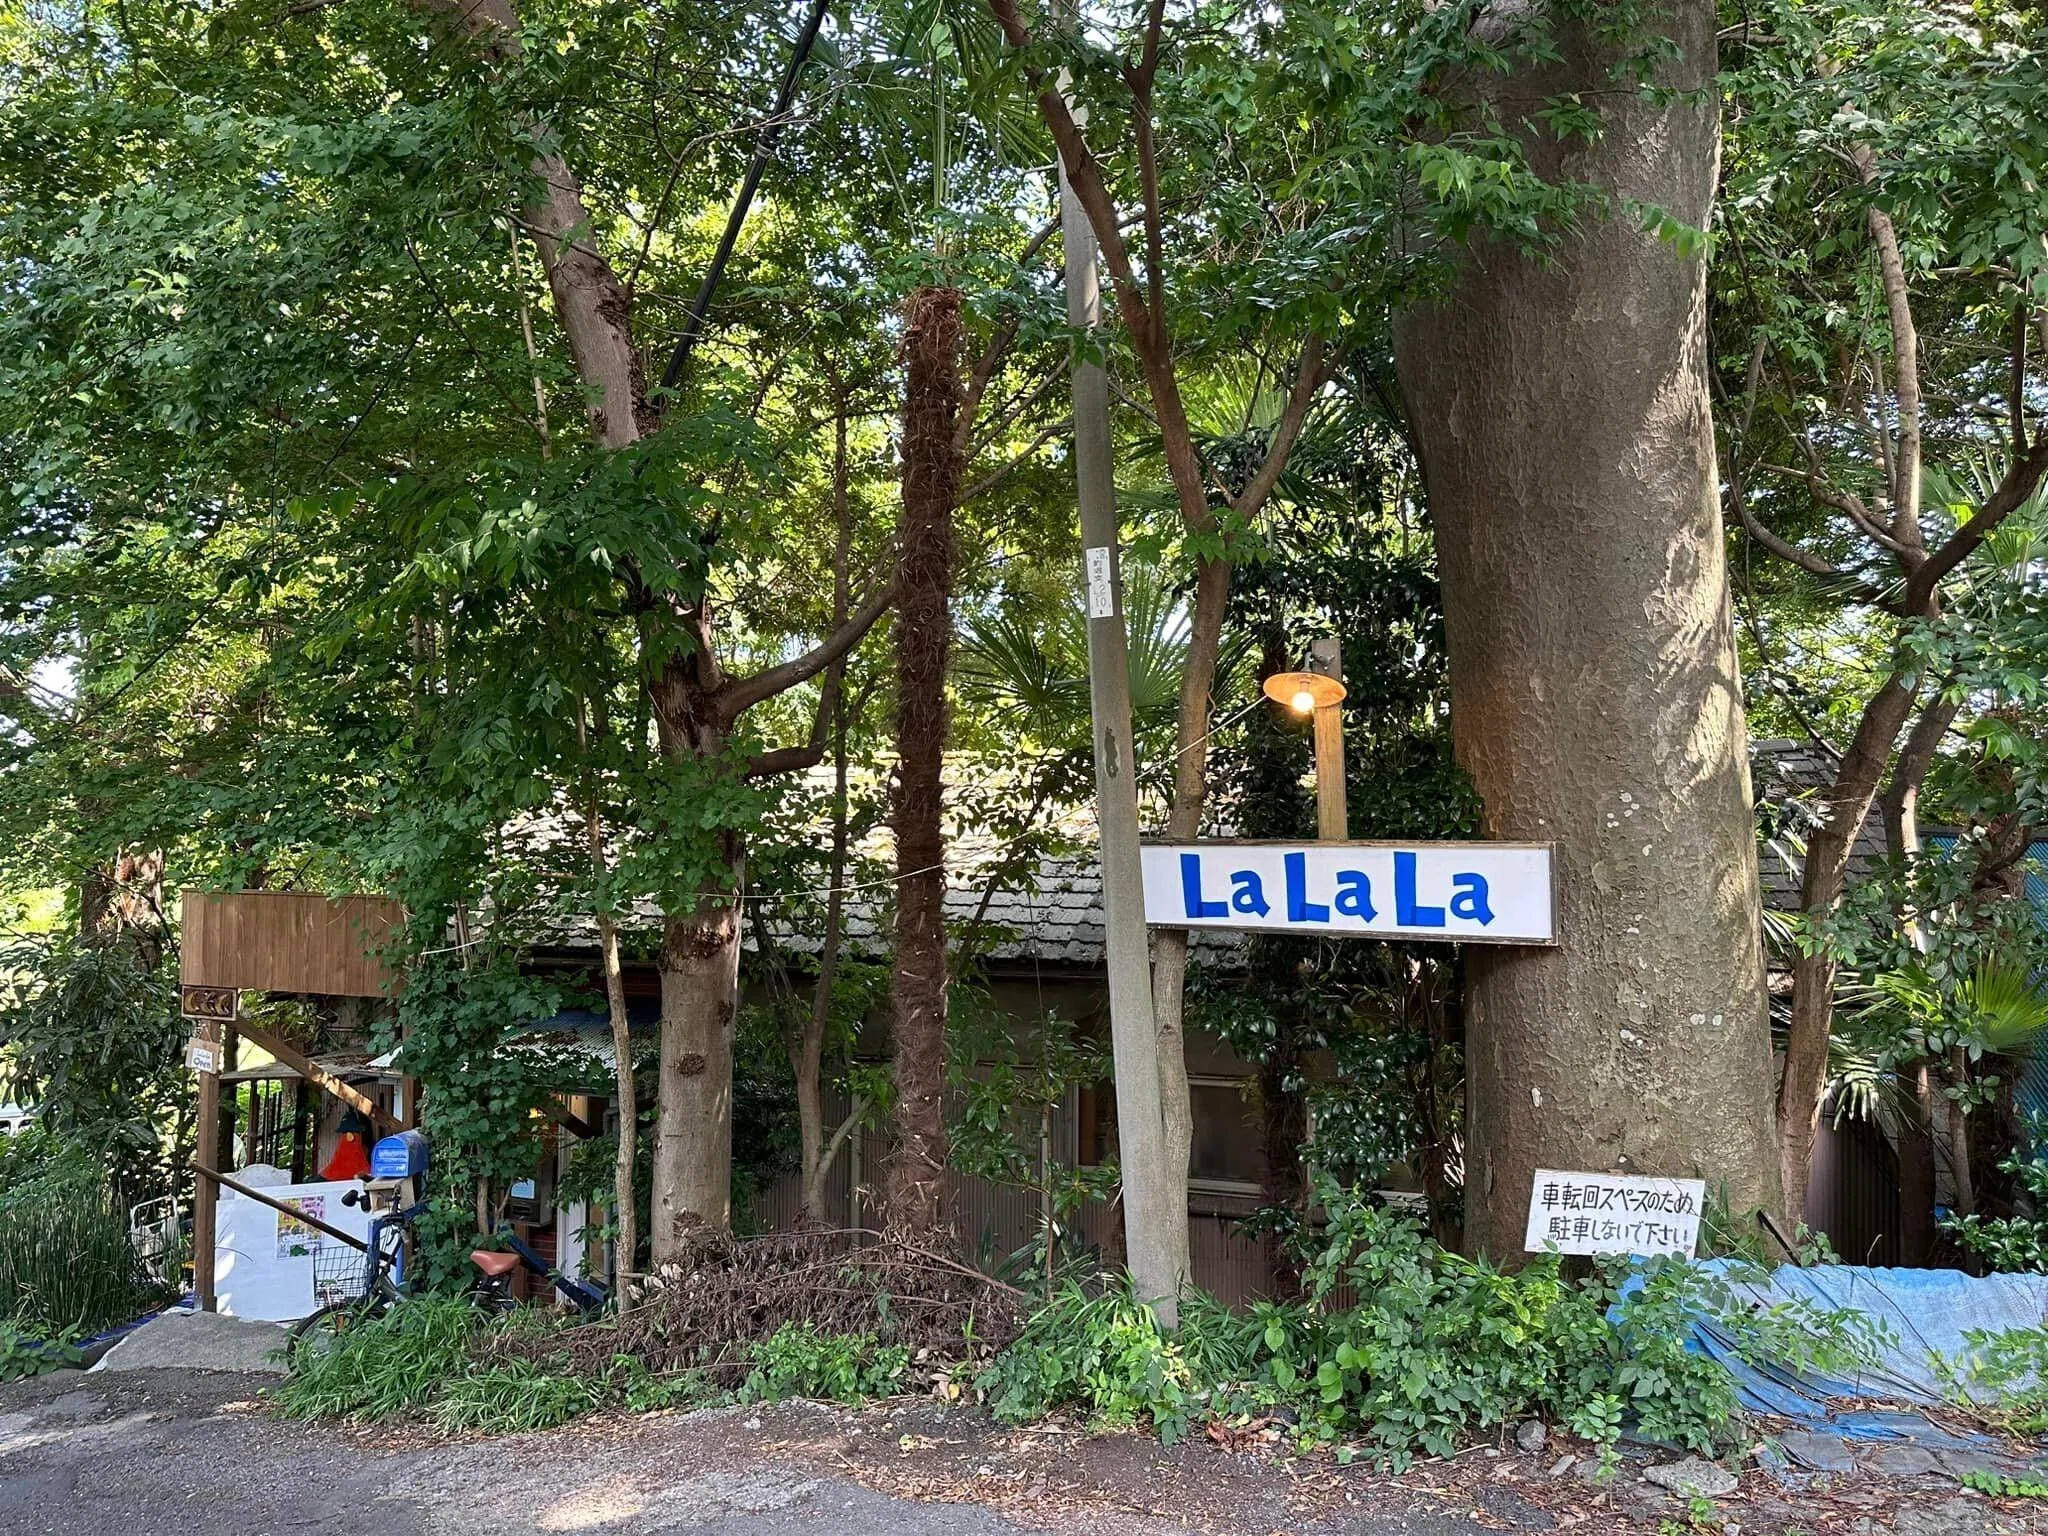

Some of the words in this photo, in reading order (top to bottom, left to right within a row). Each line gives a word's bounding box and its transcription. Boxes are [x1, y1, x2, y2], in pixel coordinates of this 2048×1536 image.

[1541, 1182, 1693, 1214] 車転回スペースのため
[1548, 1215, 1688, 1246] 駐車しないで下さい
